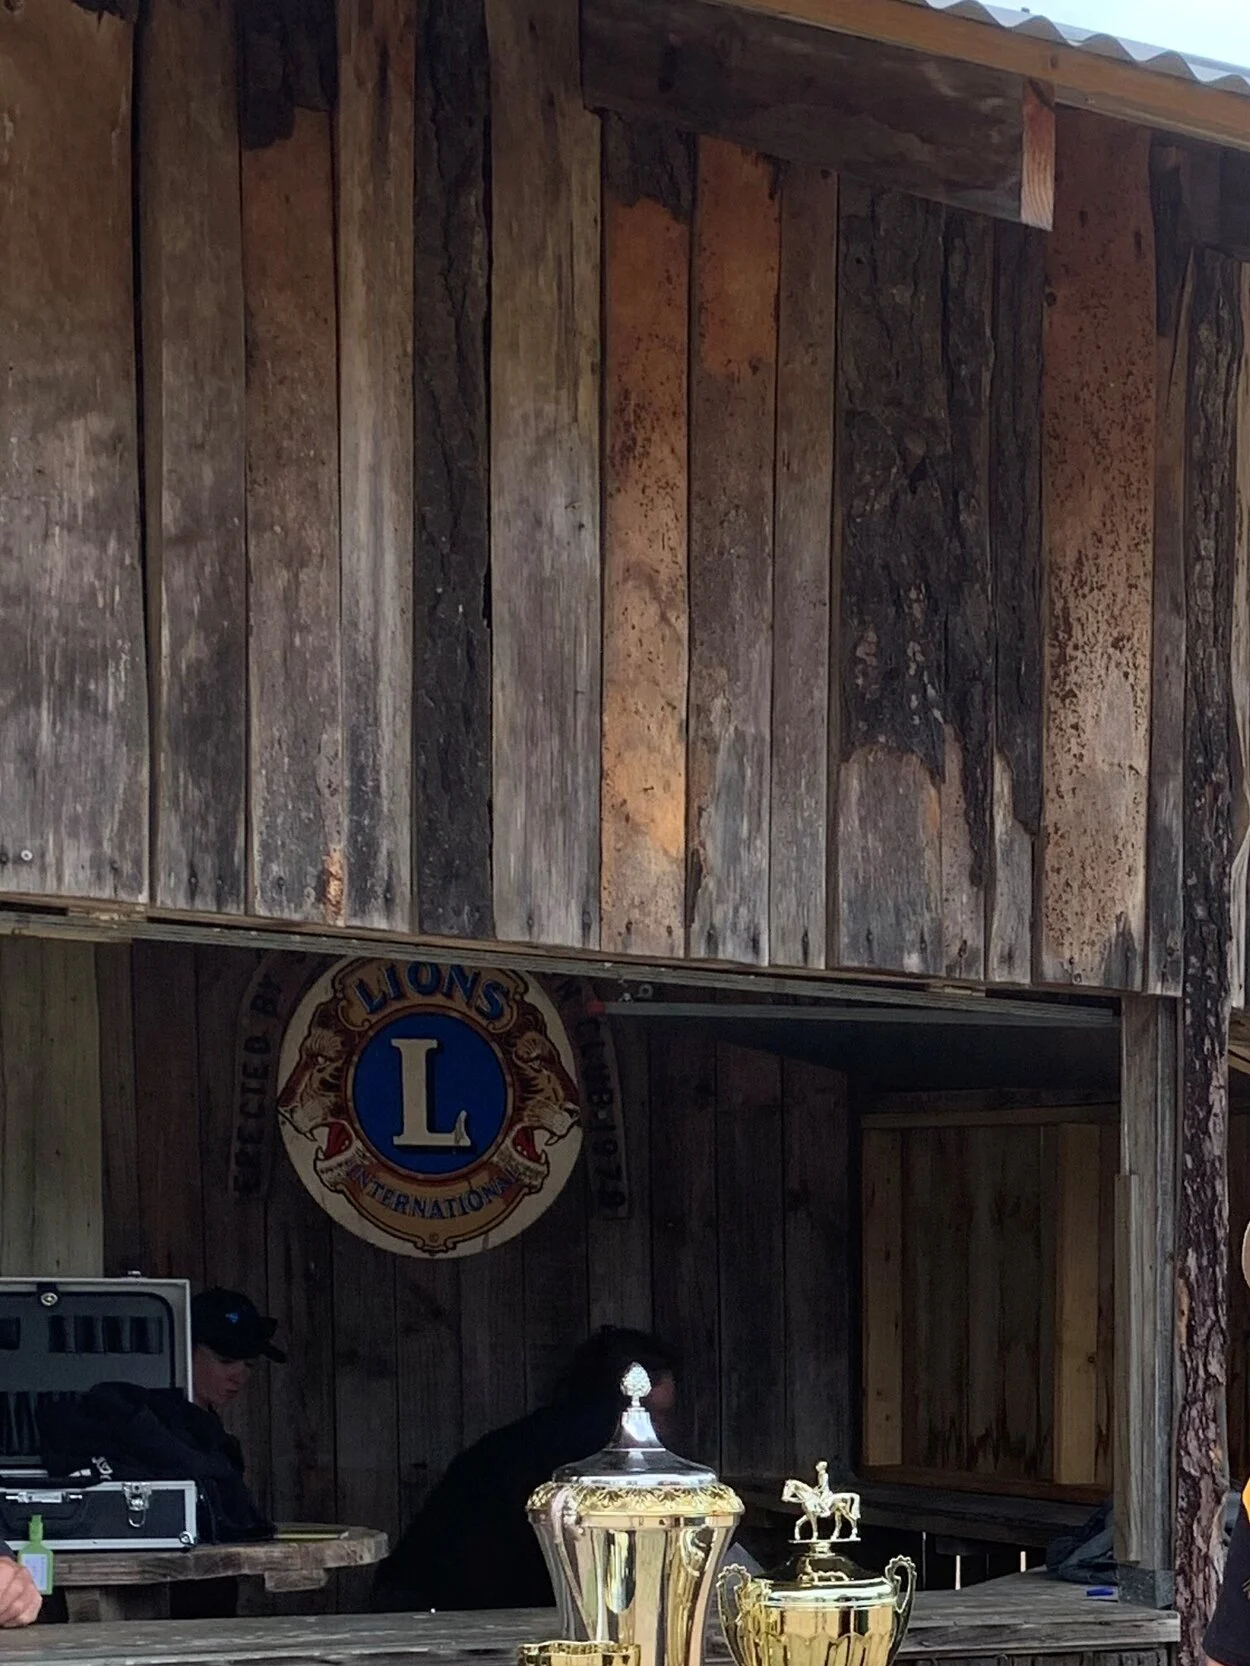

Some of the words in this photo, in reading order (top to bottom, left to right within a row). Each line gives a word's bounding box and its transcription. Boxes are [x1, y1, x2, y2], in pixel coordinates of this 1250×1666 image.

[353, 961, 510, 1021] LIONS
[391, 1038, 472, 1147] L
[347, 1163, 519, 1219] INTERNATIONAL
